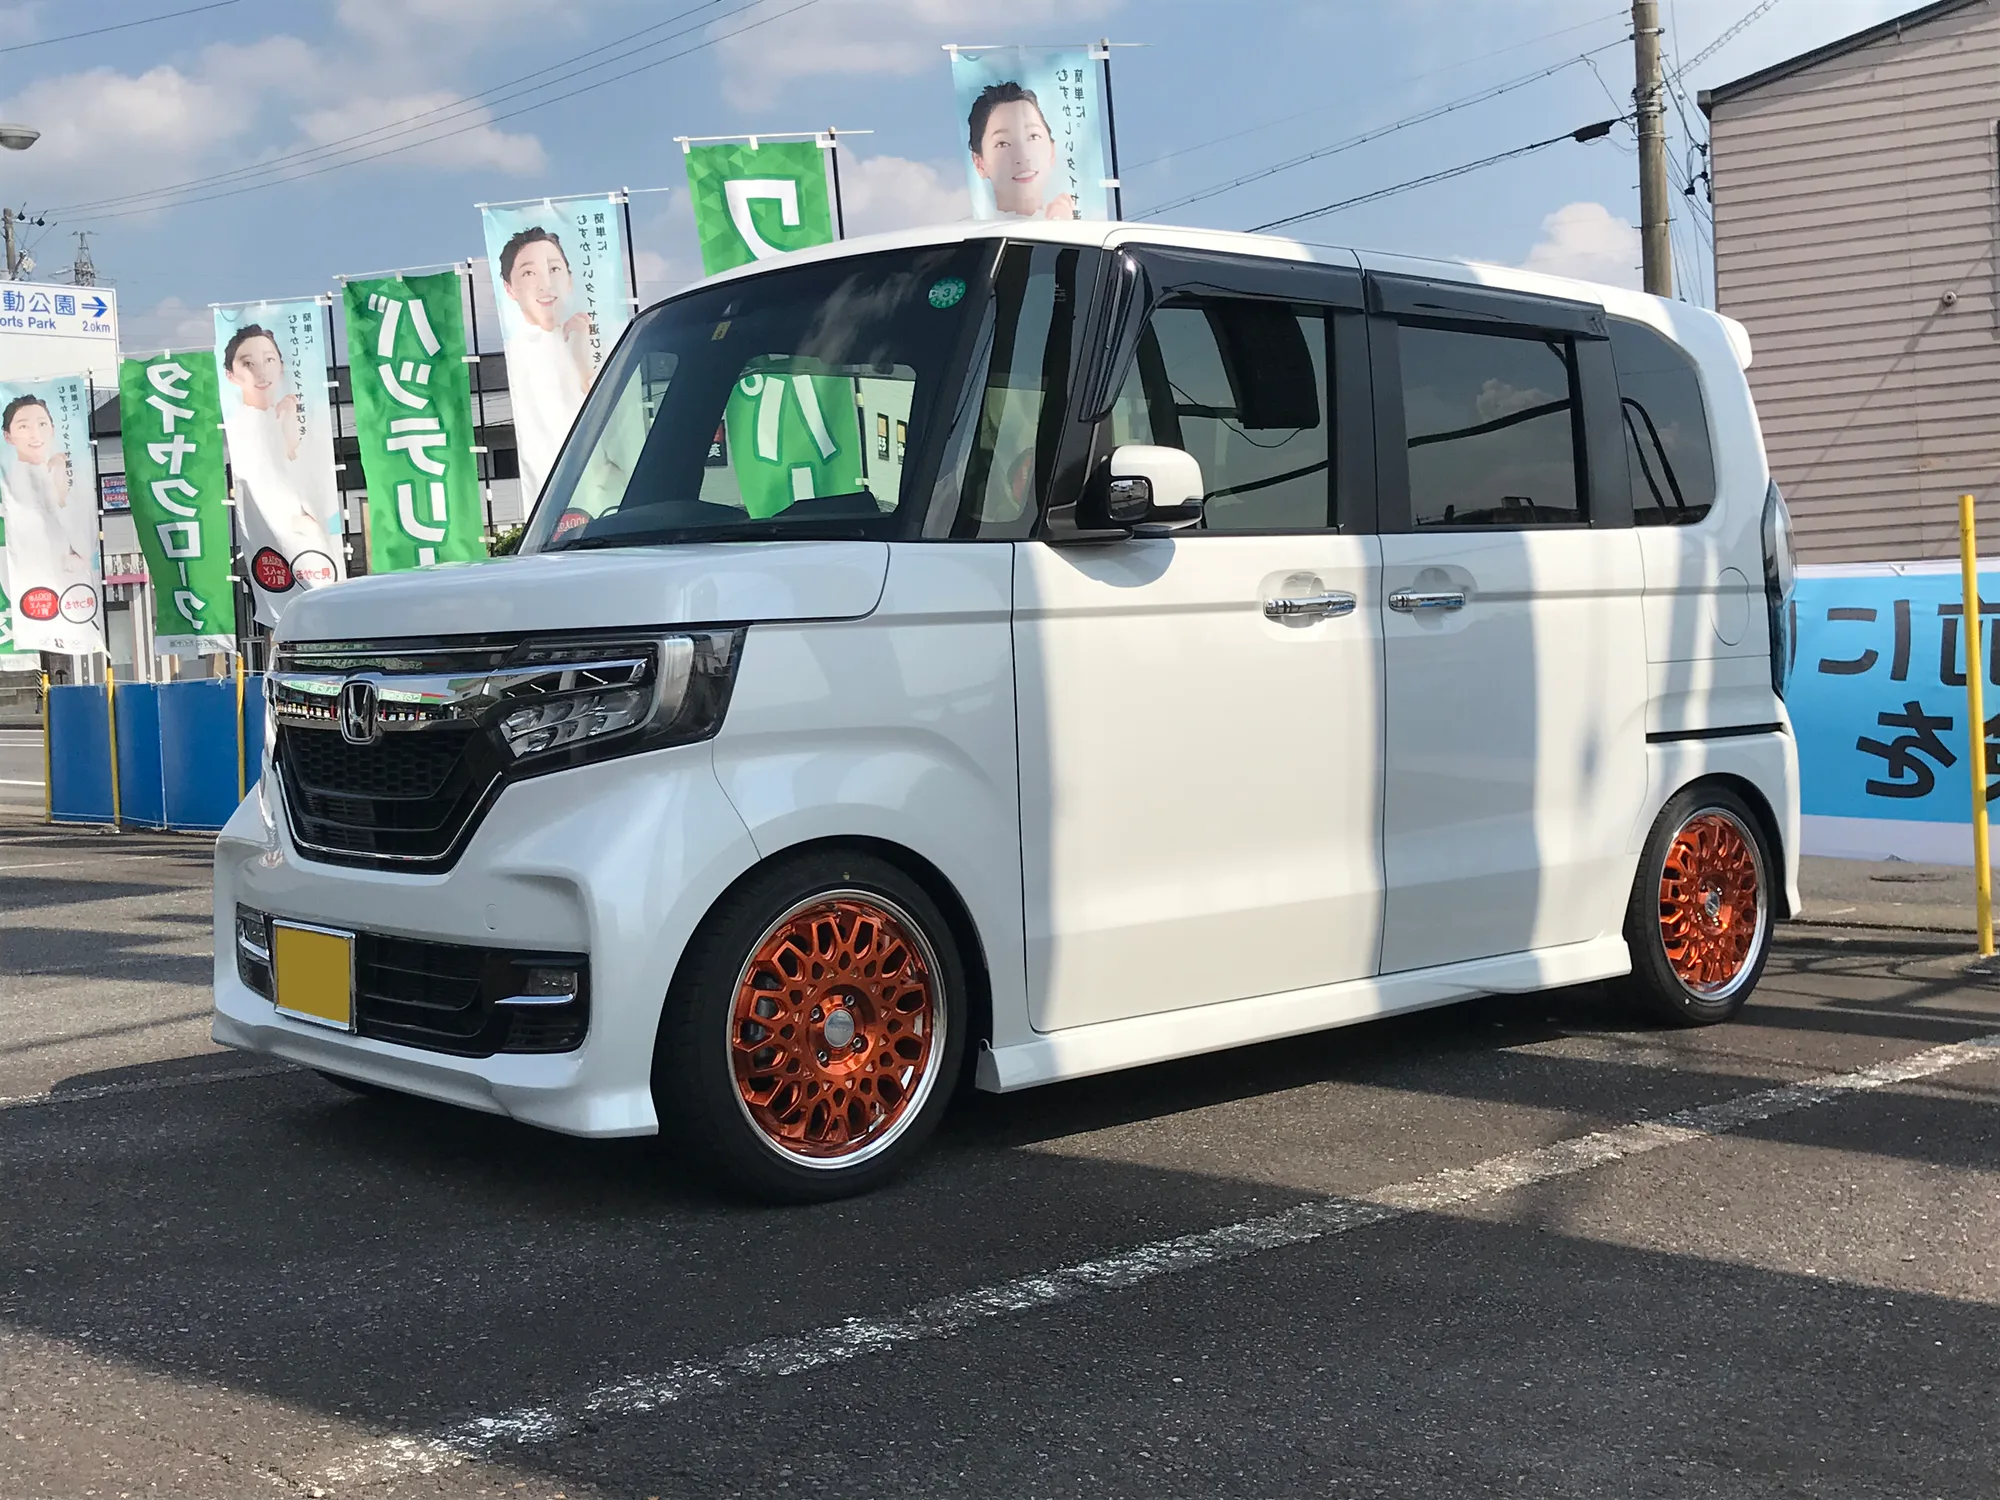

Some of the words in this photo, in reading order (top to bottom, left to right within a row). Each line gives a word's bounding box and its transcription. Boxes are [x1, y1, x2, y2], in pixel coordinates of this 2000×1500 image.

[3, 290, 76, 316] 動公園
[28, 317, 56, 330] Park
[82, 321, 110, 333] 2.0km
